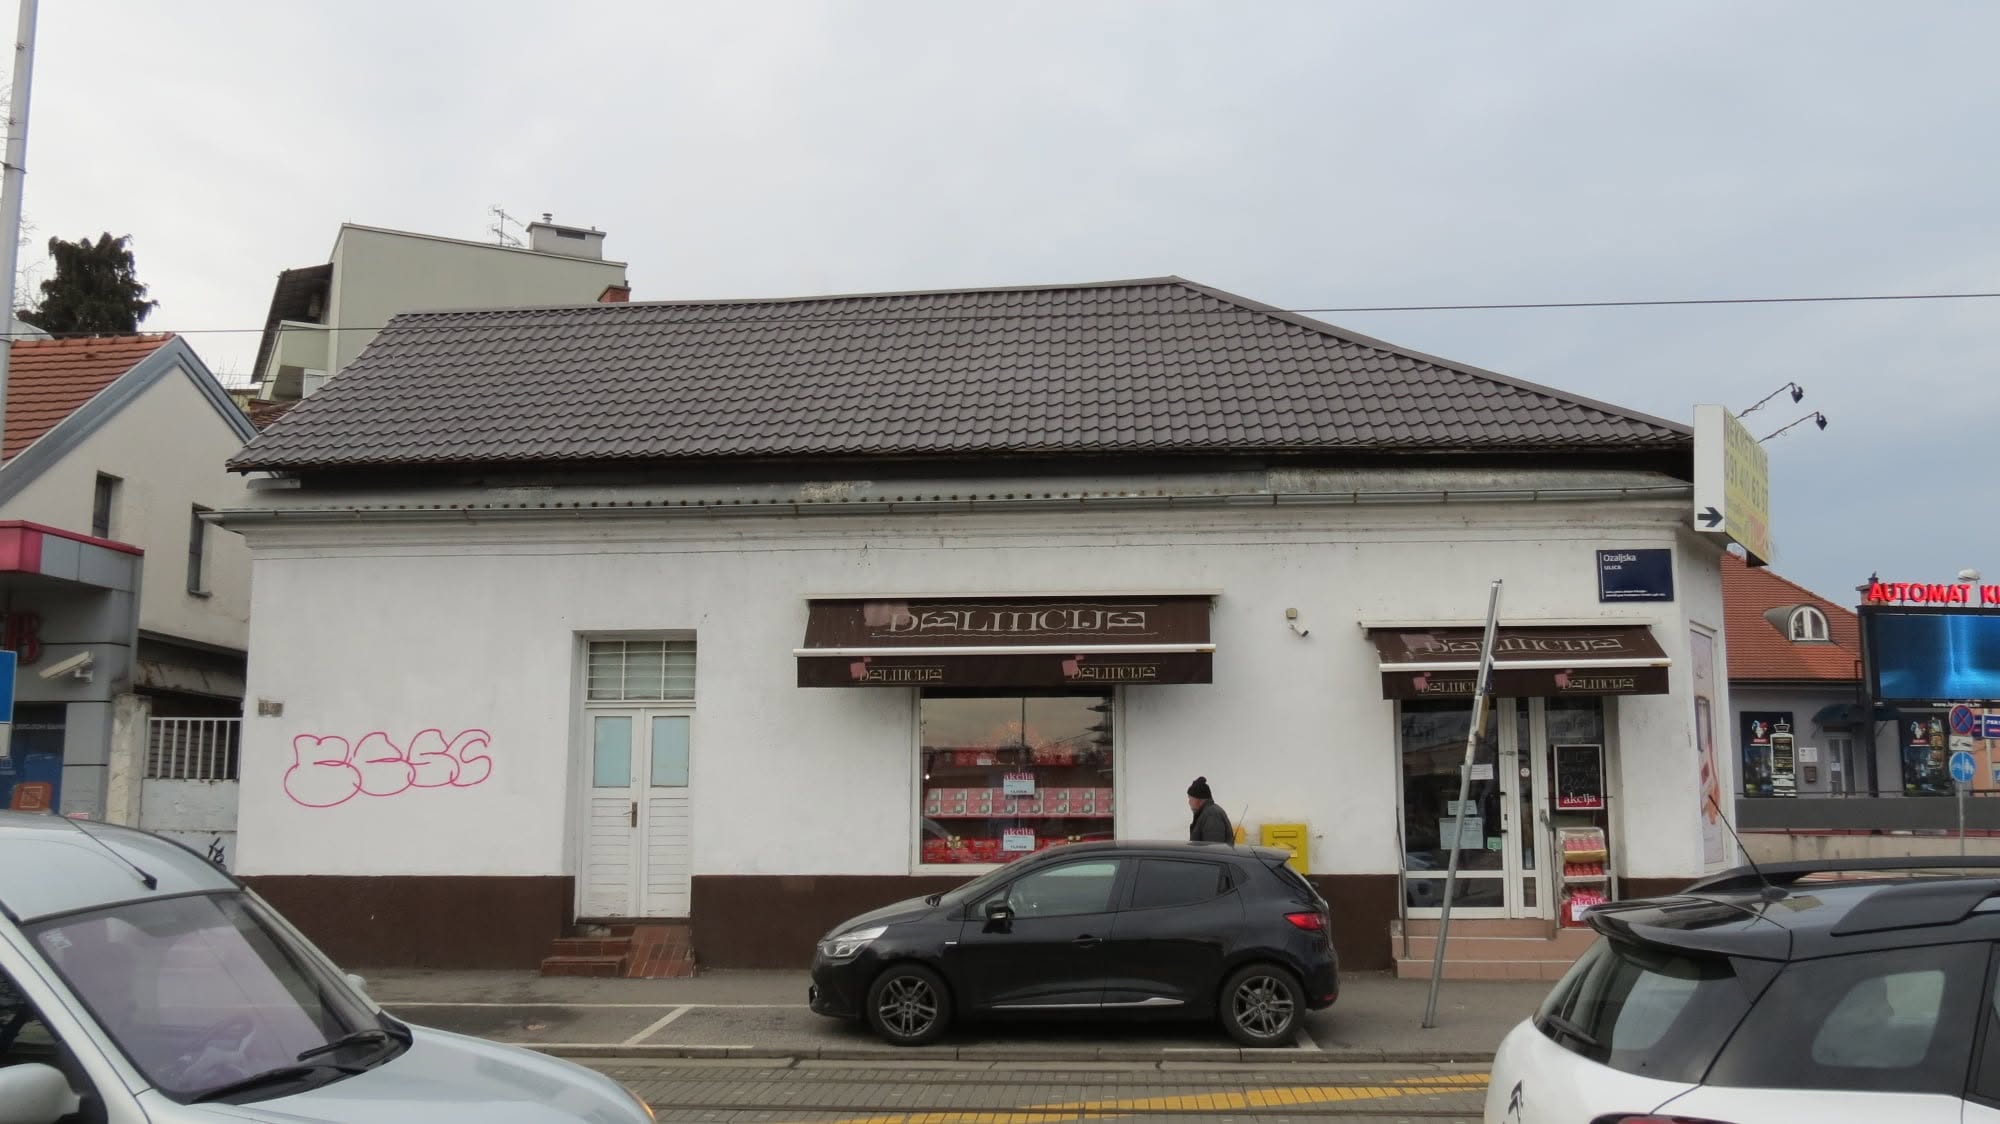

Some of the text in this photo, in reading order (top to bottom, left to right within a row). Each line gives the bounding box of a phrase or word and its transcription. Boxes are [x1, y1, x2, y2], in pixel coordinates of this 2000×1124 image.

[1603, 553, 1636, 563] Ozaljska
[1867, 582, 1971, 603] AUTOMAT
[1563, 792, 1597, 806] akcija
